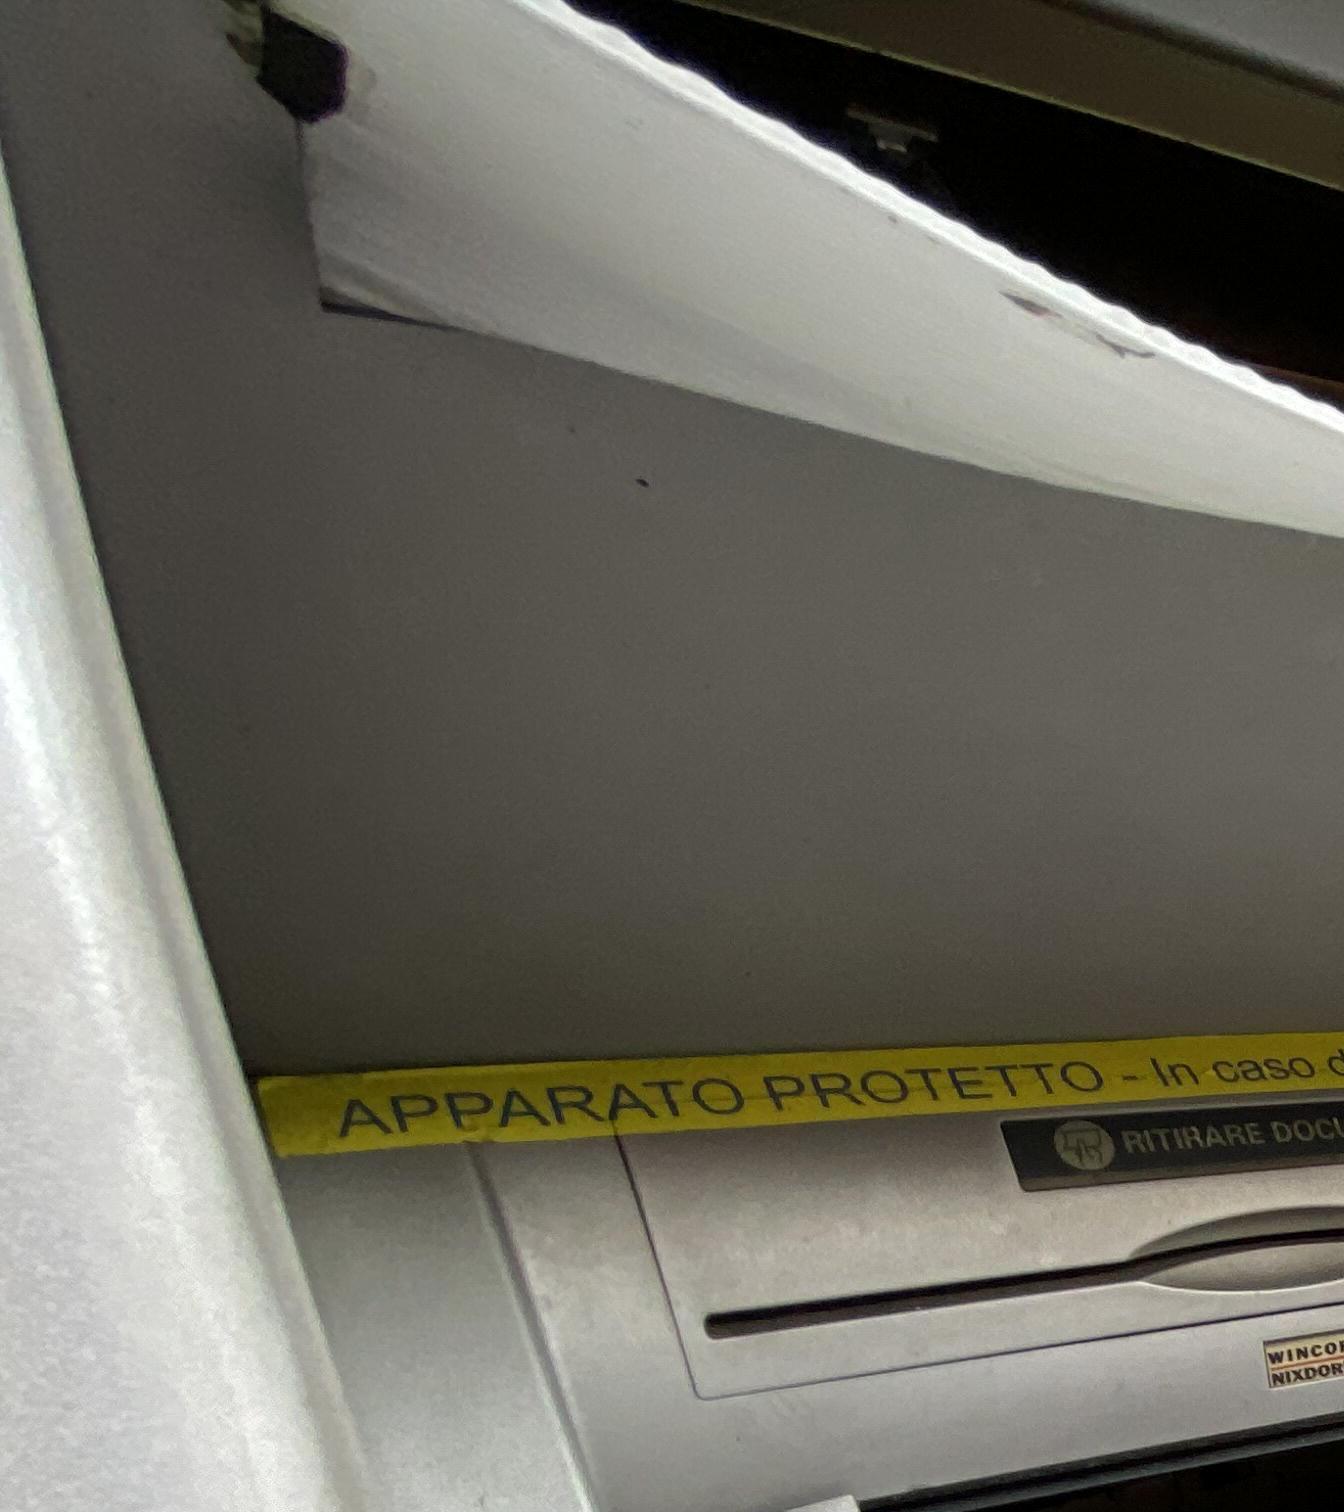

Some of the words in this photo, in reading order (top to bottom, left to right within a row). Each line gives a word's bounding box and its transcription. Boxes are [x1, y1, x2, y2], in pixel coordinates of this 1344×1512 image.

[338, 1076, 744, 1138] APPARATO
[760, 1059, 1106, 1114] PROTETTO
[1149, 1055, 1200, 1088] In
[1211, 1052, 1317, 1084] caso
[1121, 1125, 1266, 1155] RITIRARE
